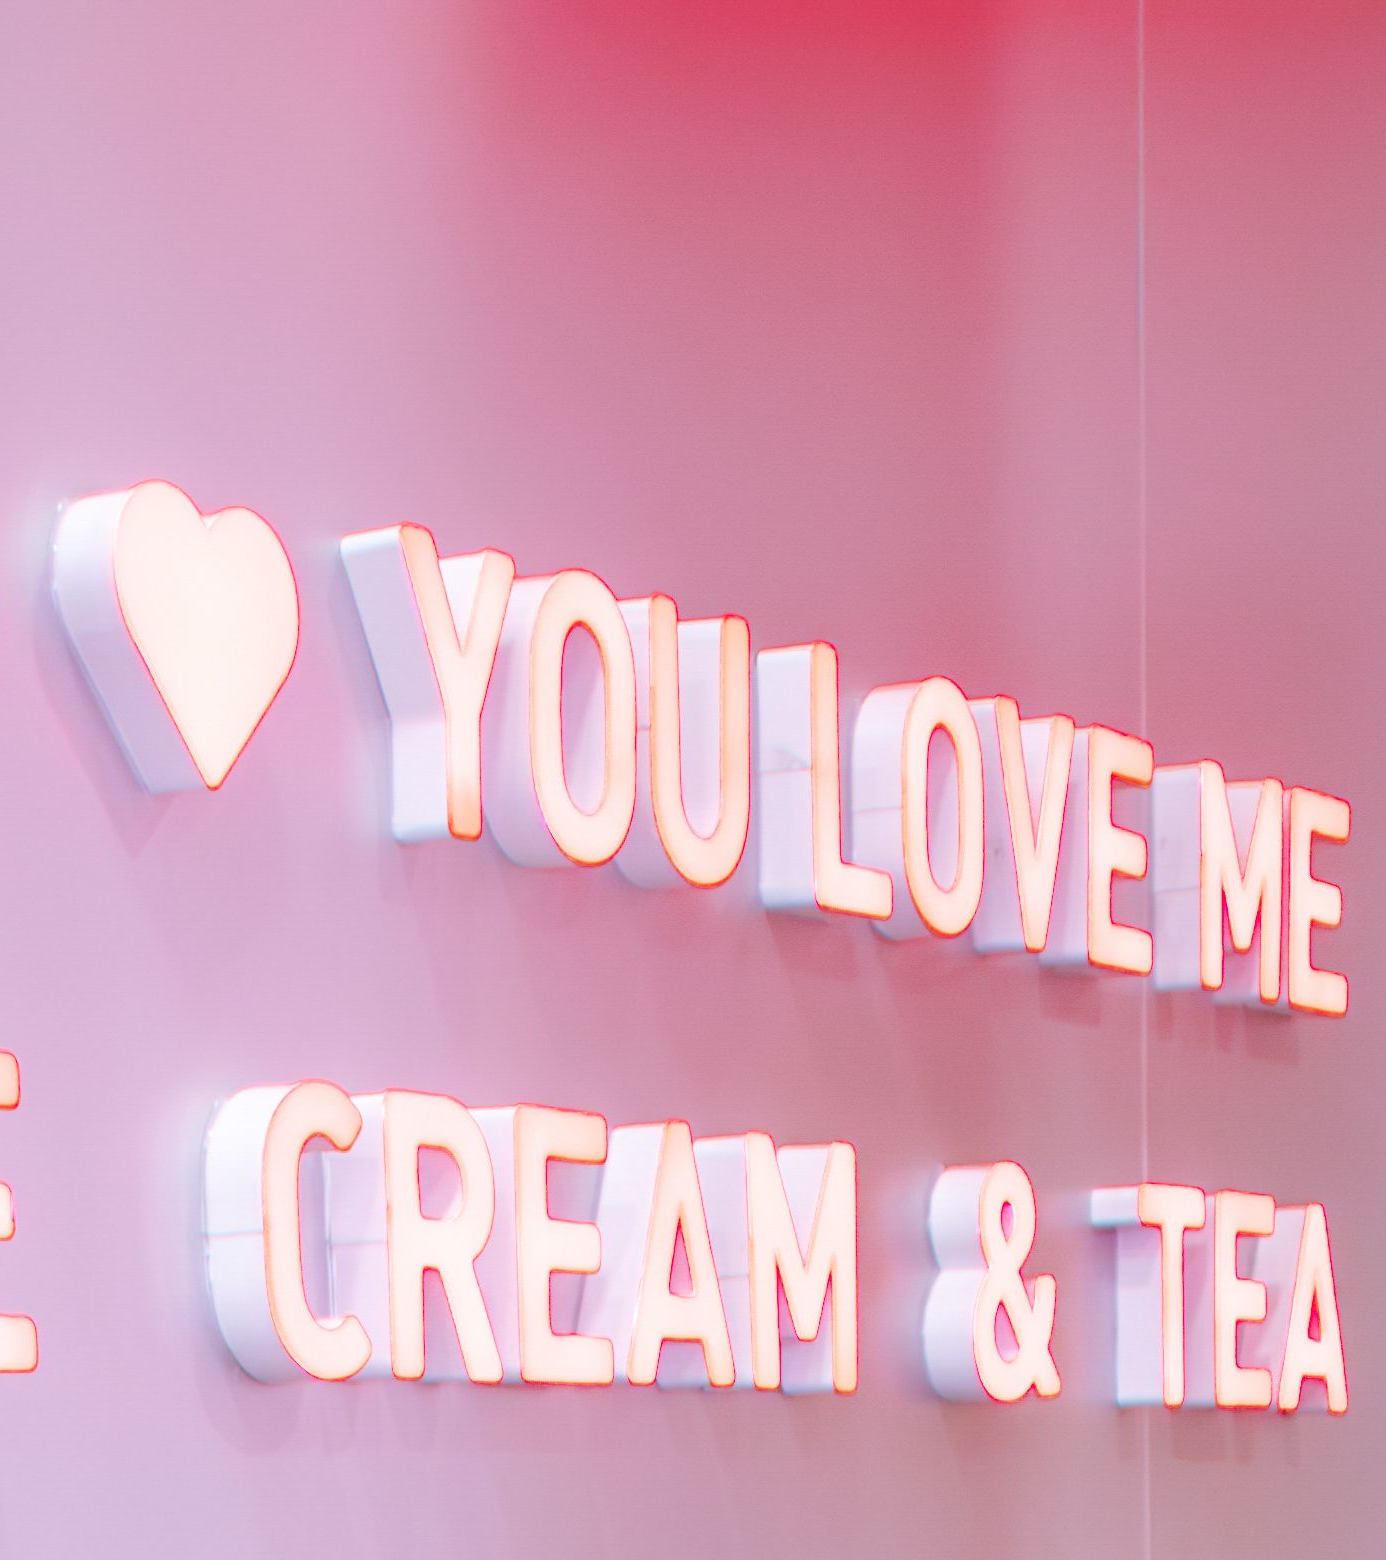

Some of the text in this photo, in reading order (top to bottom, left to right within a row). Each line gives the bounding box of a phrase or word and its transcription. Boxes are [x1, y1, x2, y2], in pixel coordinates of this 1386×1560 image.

[397, 520, 750, 889] YOU
[810, 640, 1154, 976] LOVE
[1199, 757, 1352, 1017] ME
[260, 1077, 860, 1394] CREAM
[971, 1160, 1062, 1403] &
[1137, 1181, 1349, 1415] TEA
